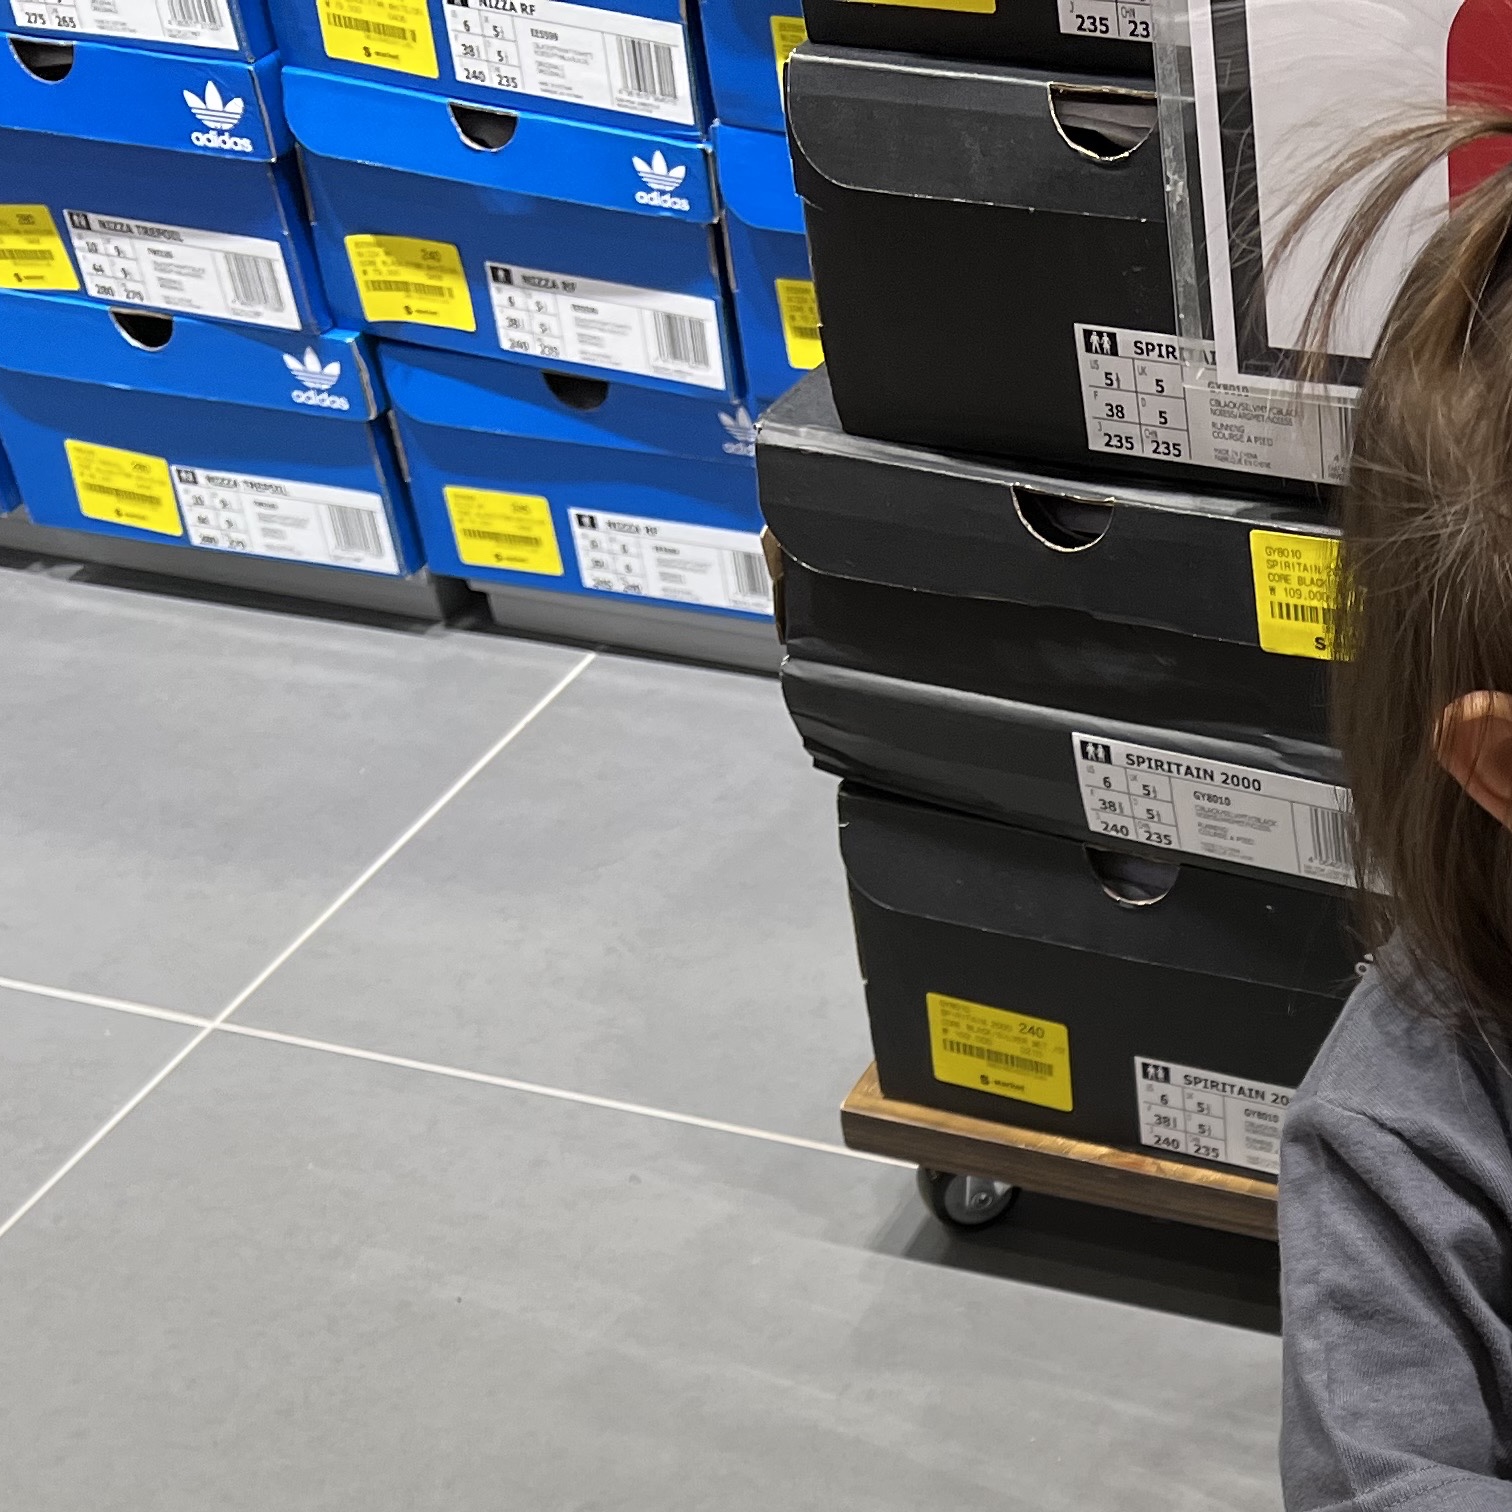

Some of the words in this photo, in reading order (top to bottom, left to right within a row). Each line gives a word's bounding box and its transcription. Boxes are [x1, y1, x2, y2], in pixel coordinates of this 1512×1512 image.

[1075, 14, 1109, 34] 235
[1128, 20, 1151, 38] 23
[191, 131, 253, 153] adidas
[634, 190, 690, 212] adidas
[1155, 379, 1165, 394] 5
[291, 390, 350, 410] adidas
[1105, 403, 1125, 419] 38
[1158, 410, 1168, 425] 5
[1103, 433, 1135, 450] 235
[1152, 440, 1182, 457] 235
[1266, 560, 1322, 574] SPIRITAIN
[1267, 572, 1292, 585] CORE
[1103, 776, 1112, 788] 6
[1126, 753, 1215, 783] SPIRITAIN
[1220, 771, 1262, 792] 2000
[1101, 821, 1129, 837] 240
[1145, 829, 1173, 846] 235
[1018, 1022, 1045, 1040] 240
[1160, 1094, 1168, 1105] 6
[1183, 1073, 1265, 1101] SPIRITAIN
[1271, 1092, 1291, 1106] 20
[1154, 1135, 1181, 1150] 240
